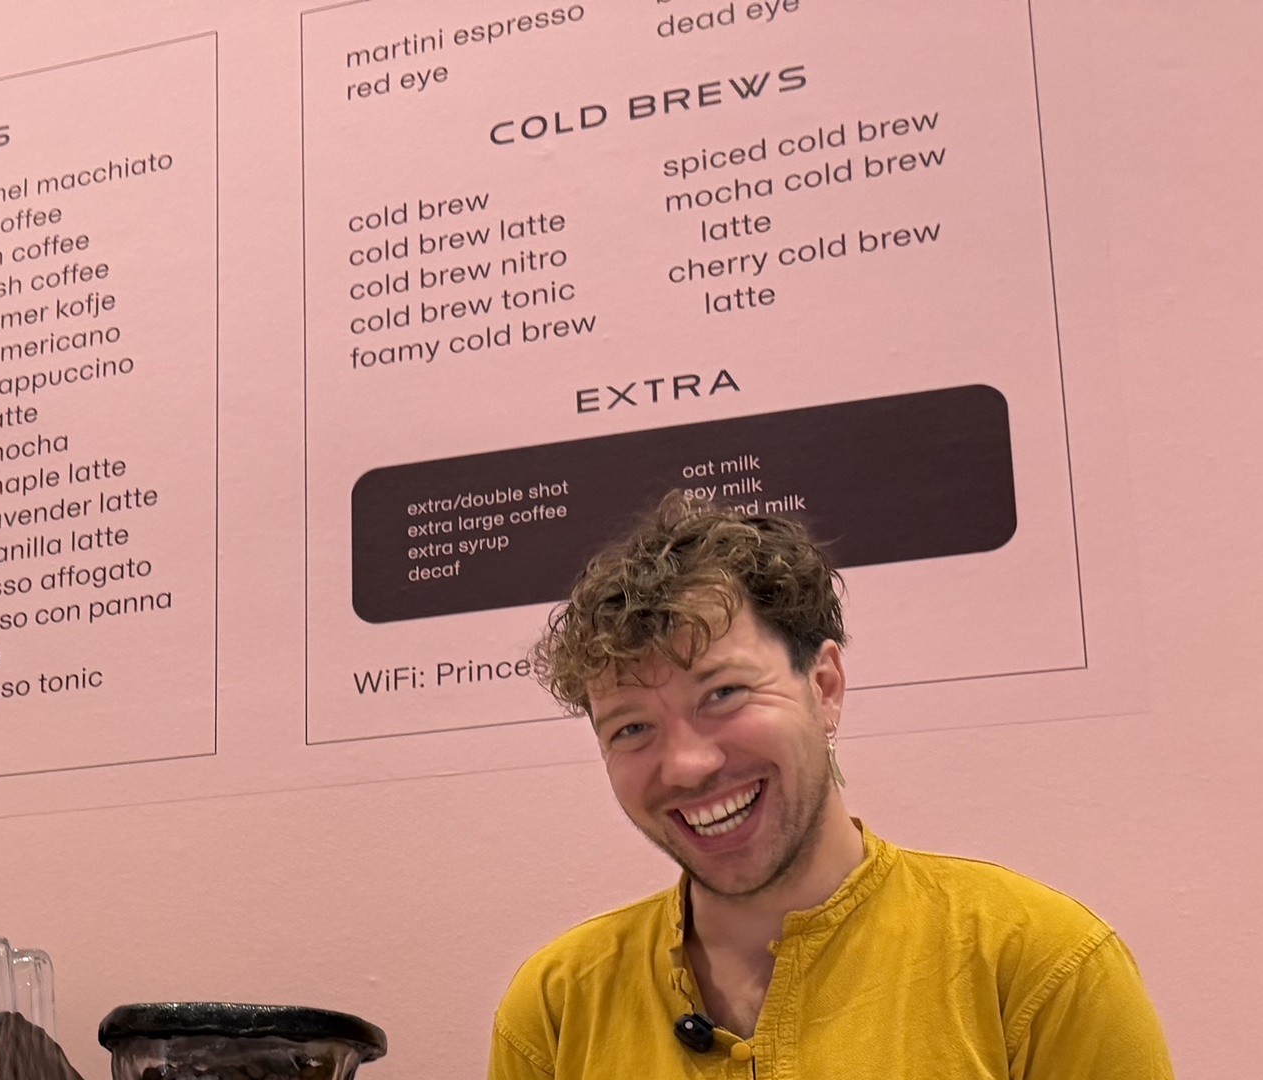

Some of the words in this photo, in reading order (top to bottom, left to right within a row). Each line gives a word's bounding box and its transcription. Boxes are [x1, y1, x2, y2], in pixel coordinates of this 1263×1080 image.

[346, 27, 444, 69] martini
[453, 4, 585, 47] espresso
[656, 1, 735, 39] dead
[745, 0, 800, 24] eye
[347, 71, 391, 102] red
[399, 65, 449, 93] eye
[489, 103, 608, 146] COLD
[628, 64, 807, 121] BREWS
[663, 137, 767, 181] spiced
[777, 123, 846, 157] cold
[857, 111, 939, 144] brew
[36, 152, 173, 196] macchiato
[665, 177, 773, 214] mocha
[784, 157, 853, 192] cold
[864, 146, 947, 179] brew
[348, 201, 408, 233] cold
[418, 192, 490, 222] brew
[701, 213, 772, 243] latte
[11, 233, 90, 263] coffee
[348, 235, 409, 267] cold
[419, 226, 491, 256] brew
[500, 212, 566, 242] latte
[668, 251, 769, 284] cherry
[777, 232, 847, 266] cold
[858, 222, 941, 254] brew
[30, 262, 110, 292] coffee
[349, 269, 410, 301] cold
[419, 261, 492, 290] brew
[501, 249, 568, 277] nitro
[56, 291, 116, 320] kofje
[349, 303, 410, 335] cold
[420, 295, 493, 325] brew
[500, 280, 576, 311] tonic
[704, 285, 776, 315] latte
[349, 339, 441, 370] foamy
[448, 322, 511, 354] cold
[522, 314, 597, 344] brew
[575, 368, 741, 415] EXTRA
[68, 457, 127, 485] latte
[682, 459, 715, 479] oat
[720, 454, 761, 473] milk
[99, 486, 159, 514] latte
[407, 486, 524, 516] extra/double
[528, 479, 569, 500] shot
[683, 484, 717, 502] soy
[723, 477, 763, 496] milk
[765, 495, 806, 514] milk
[407, 520, 453, 538] extra
[458, 513, 505, 532] large
[509, 503, 568, 524] coffee
[71, 526, 130, 553] latte
[407, 542, 453, 560] extra
[458, 535, 510, 556] syrup
[40, 557, 152, 591] affogato
[407, 559, 461, 582] decaf
[34, 603, 81, 626] con
[89, 591, 172, 625] panna
[37, 666, 103, 694] tonic
[352, 665, 425, 695] WiFi:
